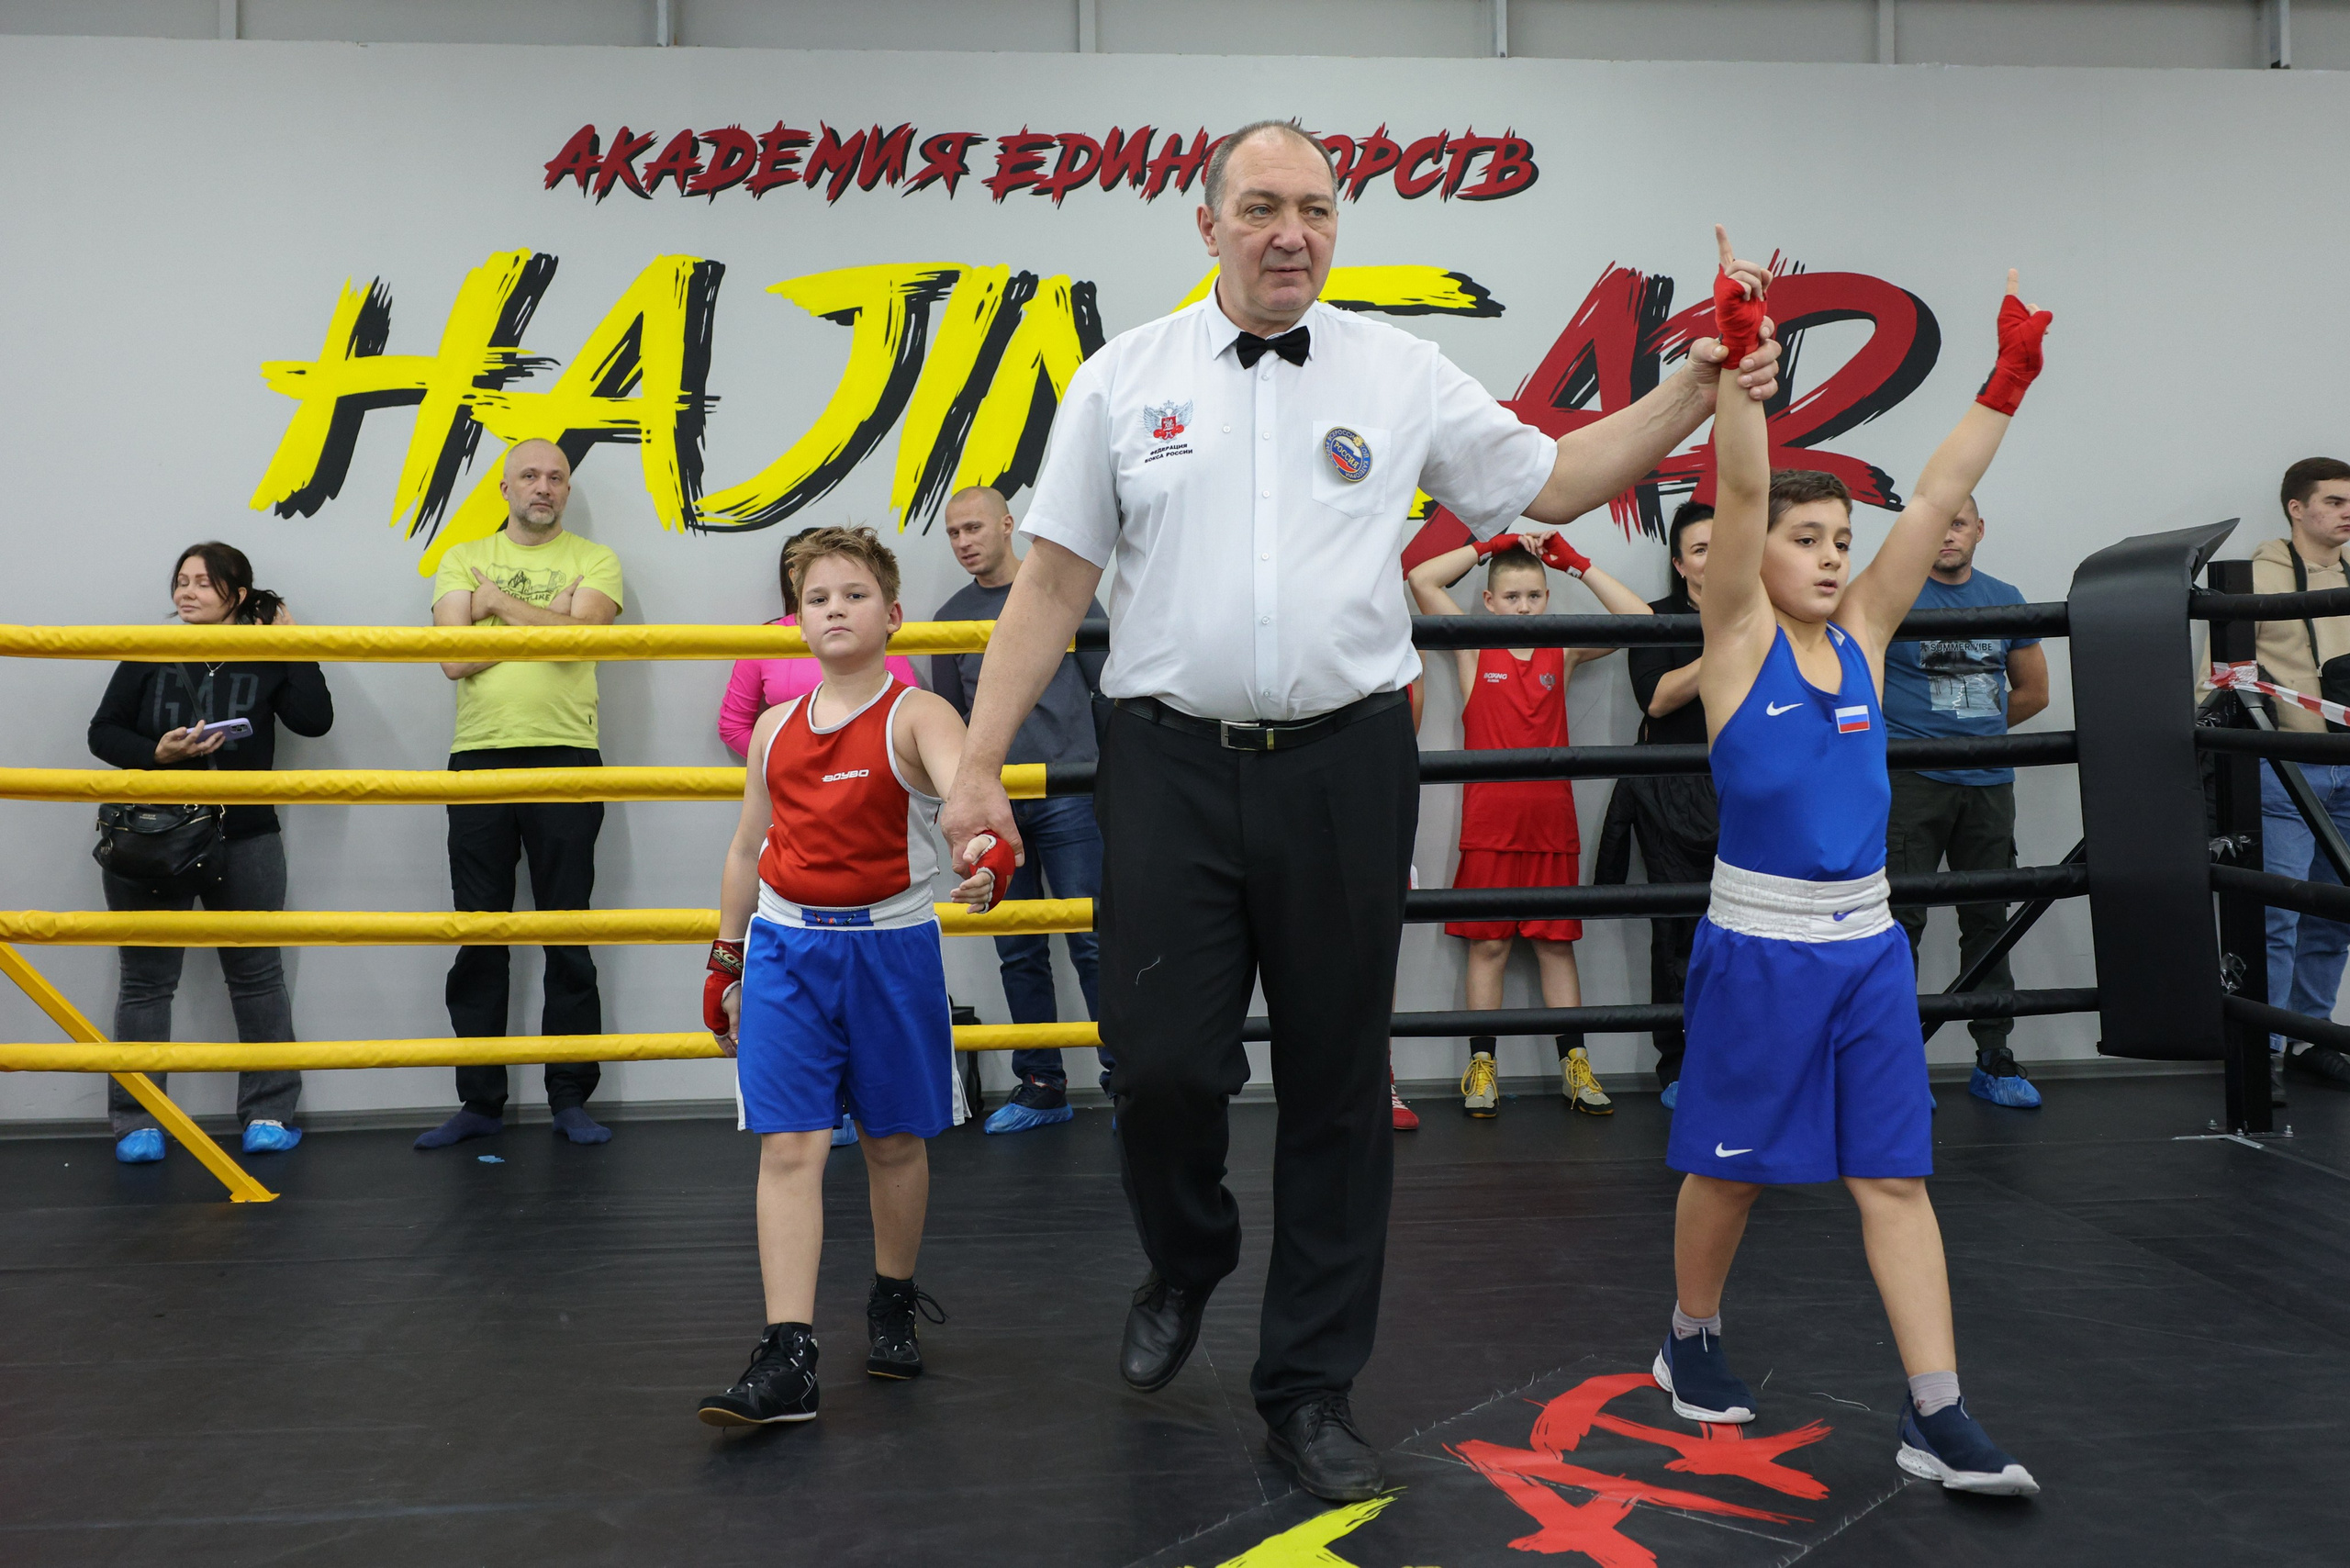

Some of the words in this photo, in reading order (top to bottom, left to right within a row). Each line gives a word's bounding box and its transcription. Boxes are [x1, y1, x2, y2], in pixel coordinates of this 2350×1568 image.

[1144, 454, 1164, 463] БОКСА
[1166, 449, 1193, 457] РОССИИ
[1149, 443, 1188, 455] ФЕДЕРАЦИЯ
[1333, 441, 1360, 469] РОССИЯ
[1930, 643, 1970, 652] SUMMER
[1973, 643, 1993, 651] VIBE
[153, 665, 259, 751] GAP
[821, 768, 870, 783] BOYBO
